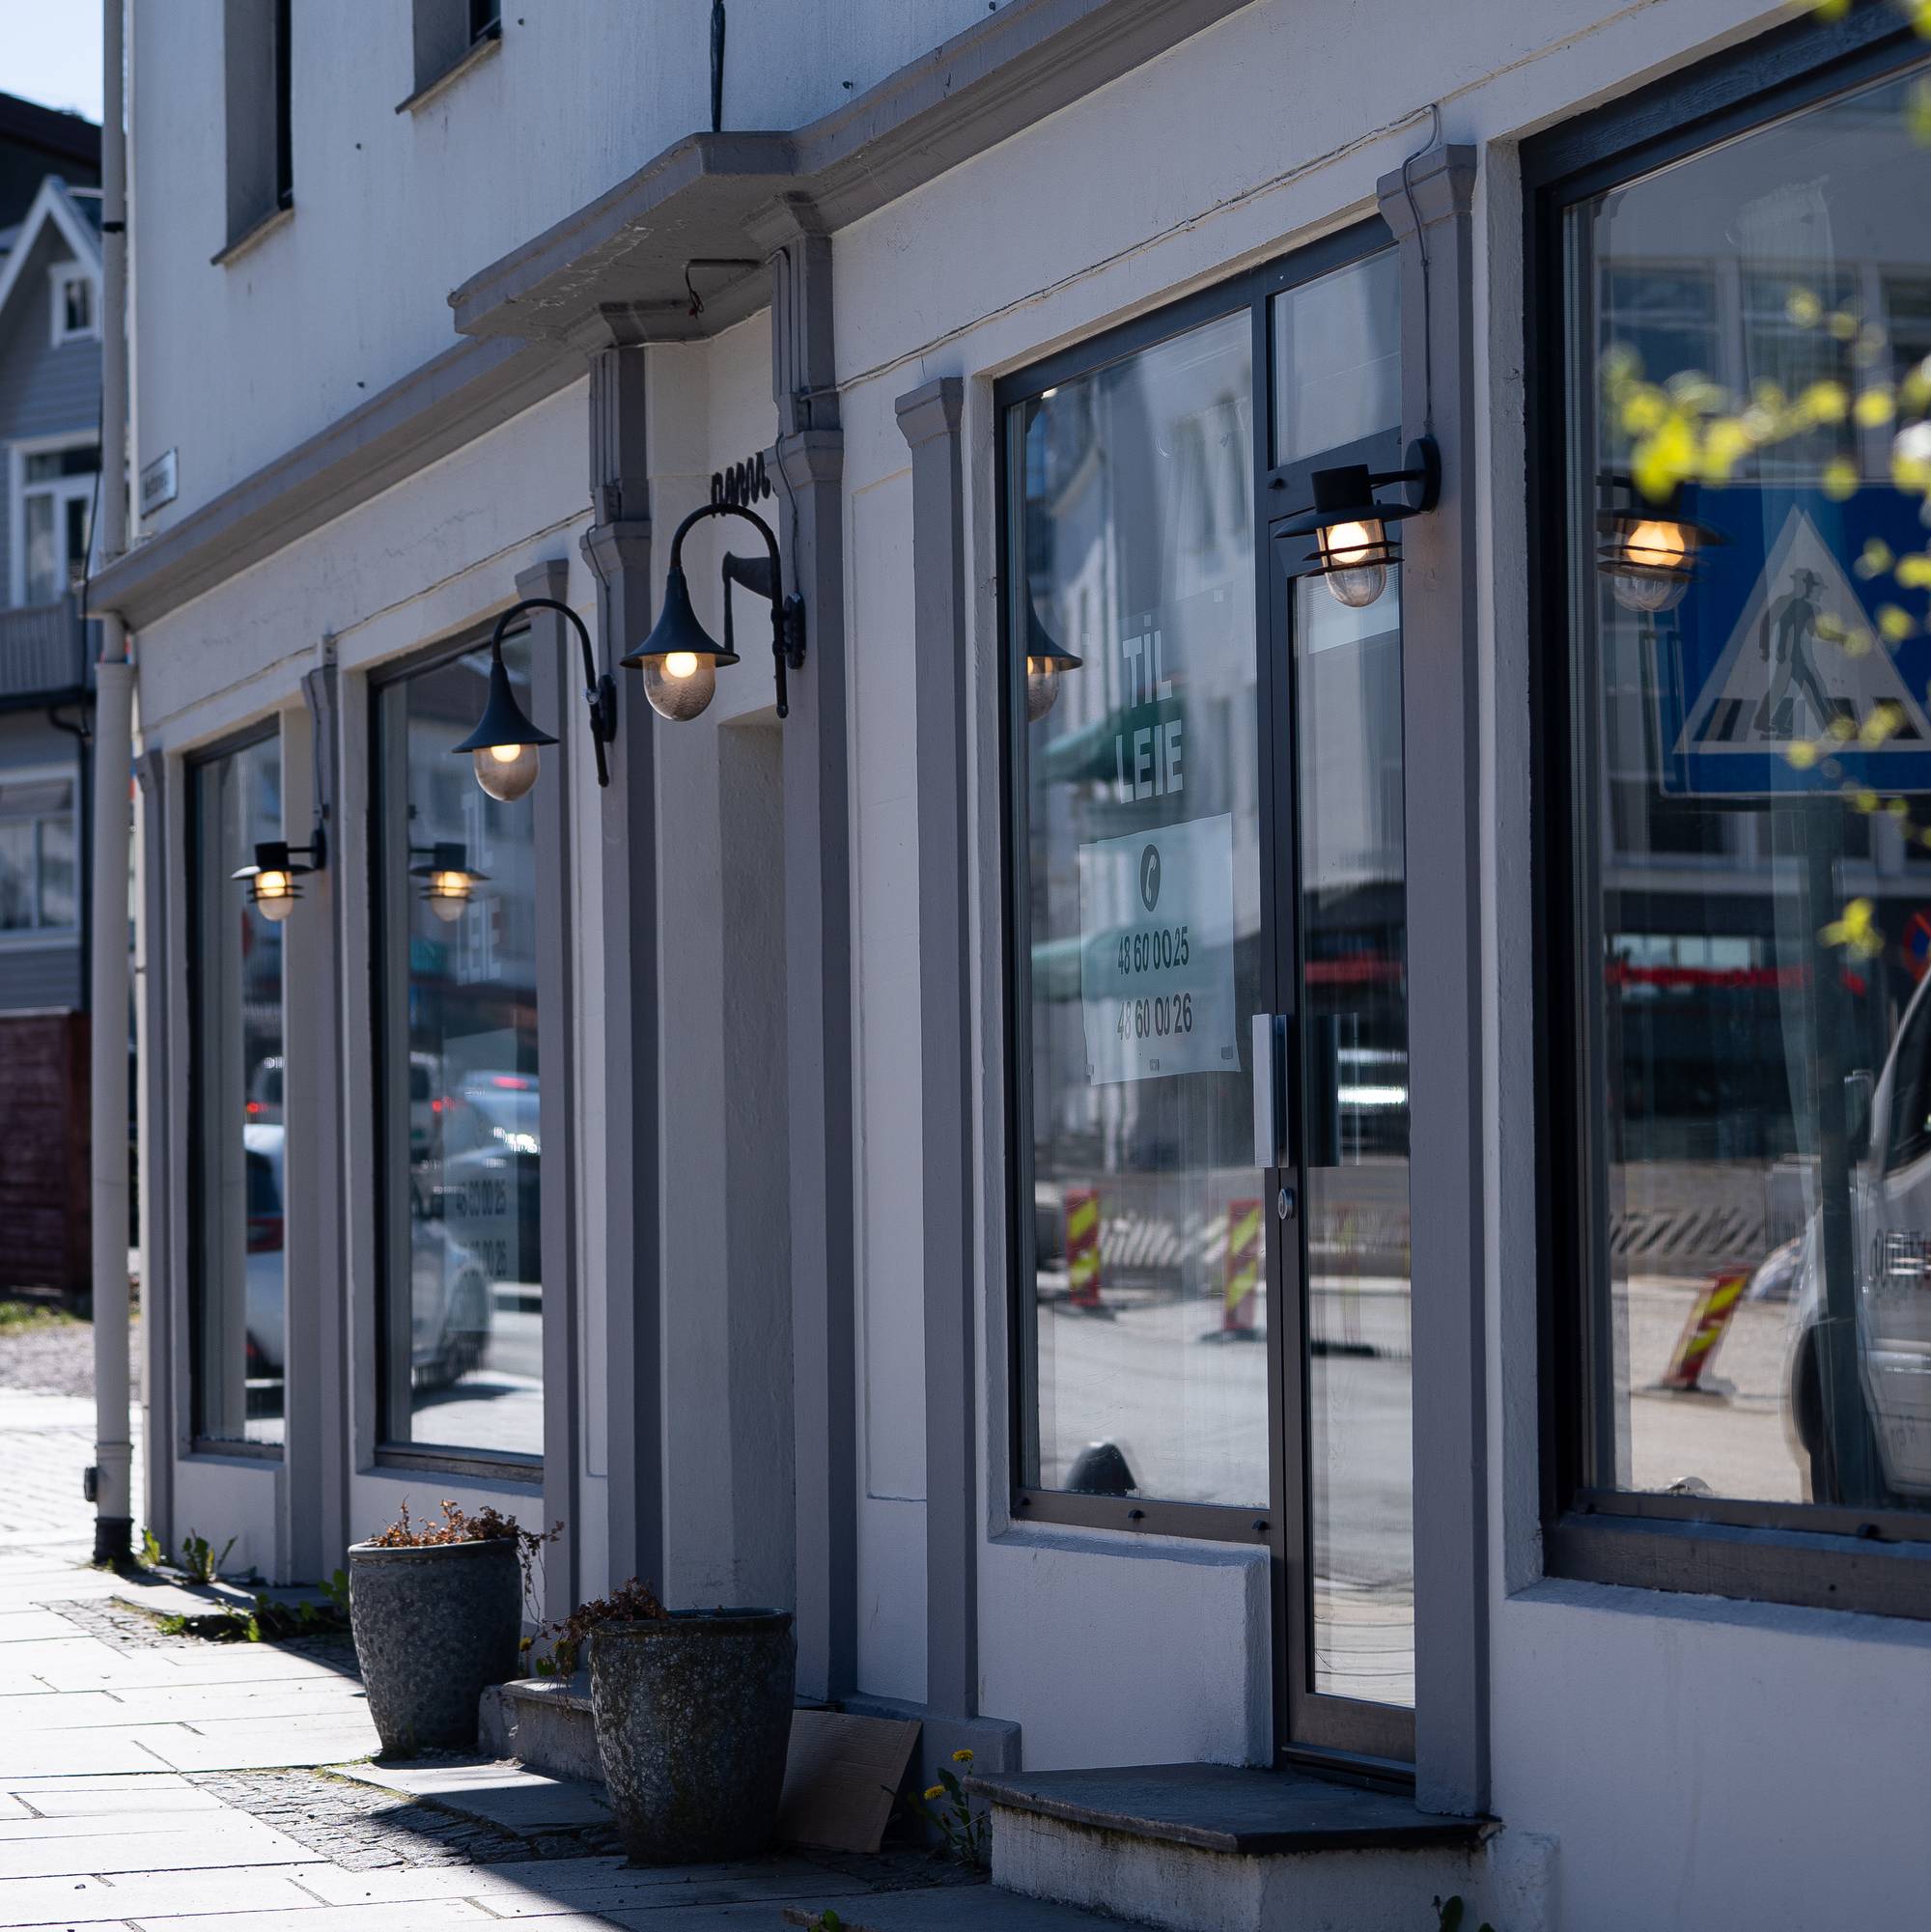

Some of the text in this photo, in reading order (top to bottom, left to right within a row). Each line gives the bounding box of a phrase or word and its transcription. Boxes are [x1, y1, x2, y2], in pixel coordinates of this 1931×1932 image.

[1116, 719, 1184, 803] LEIE
[1118, 936, 1131, 975] 48
[1133, 933, 1150, 972] 60
[1173, 926, 1189, 967] 25
[1117, 993, 1192, 1040] 48 60 00 26
